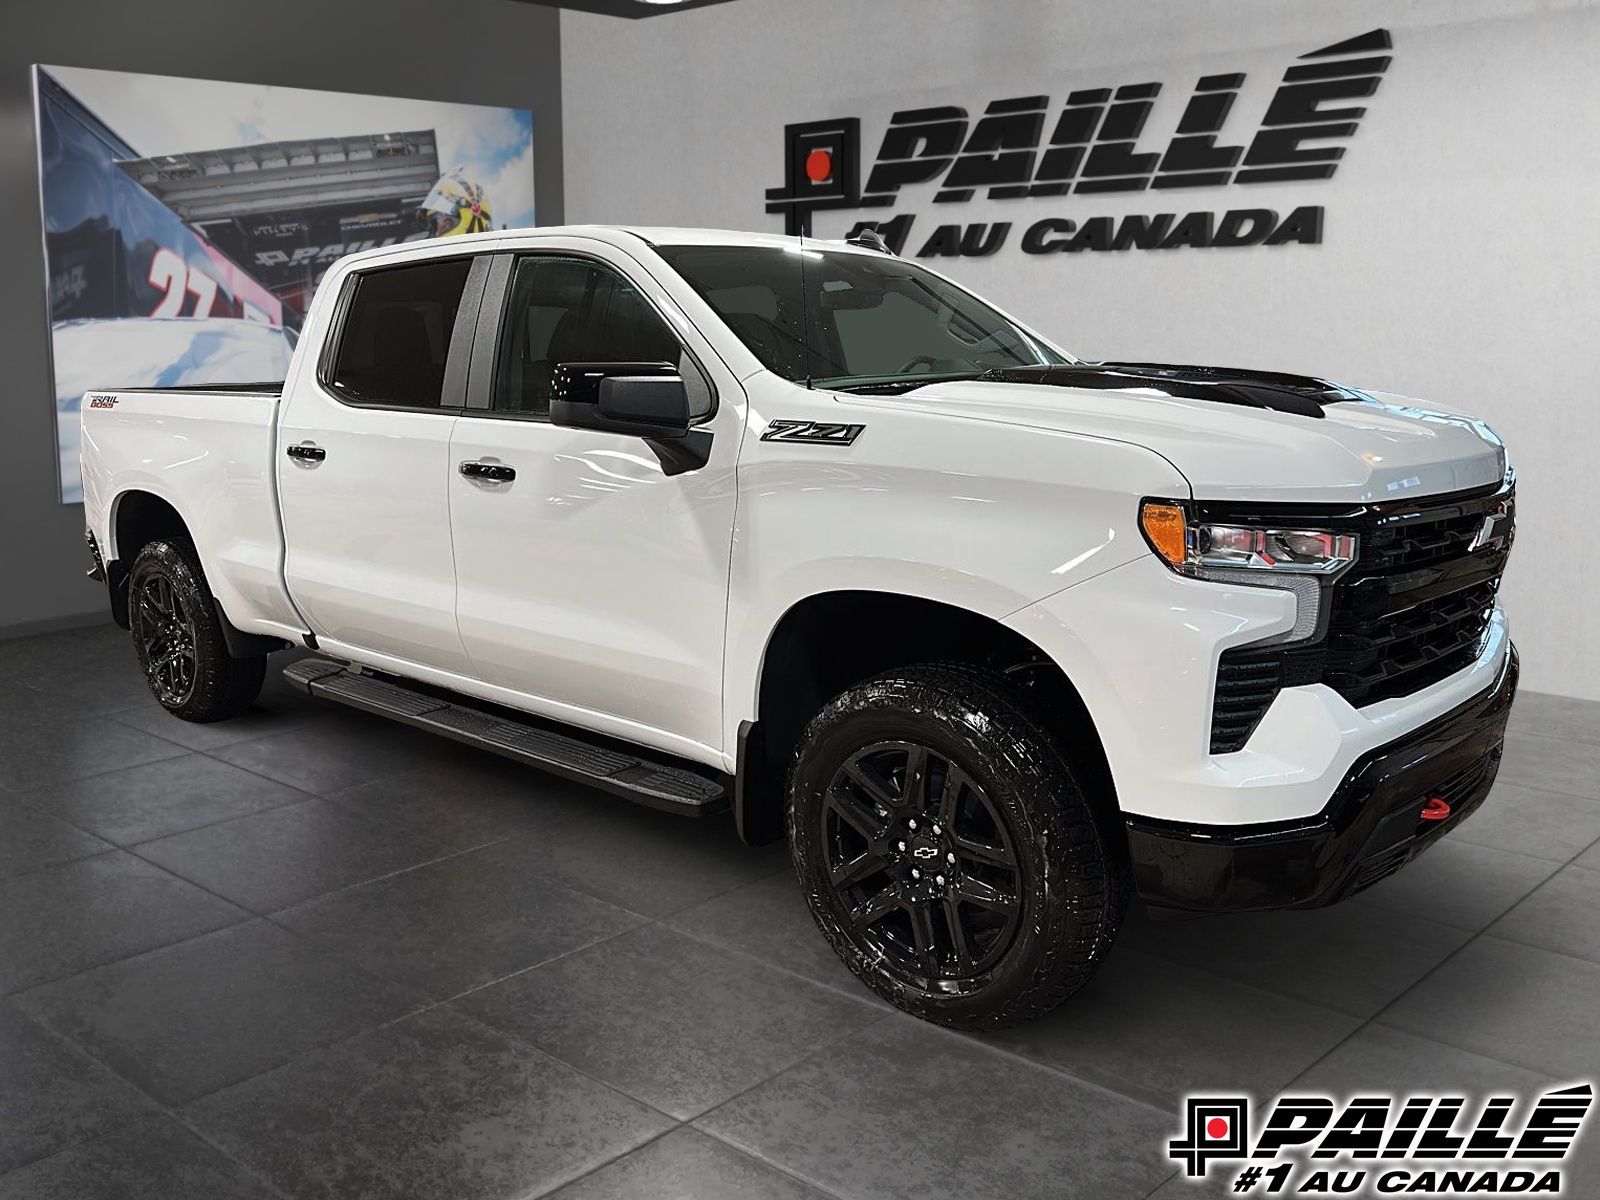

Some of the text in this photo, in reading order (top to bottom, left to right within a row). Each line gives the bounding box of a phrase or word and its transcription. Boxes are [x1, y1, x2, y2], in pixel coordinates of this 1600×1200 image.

[860, 28, 1392, 208] PAILLÉ
[916, 222, 1012, 257] AU
[1020, 205, 1324, 256] CANADA
[149, 247, 217, 319] 27
[90, 395, 119, 403] TRAIL
[760, 419, 866, 446] Z71
